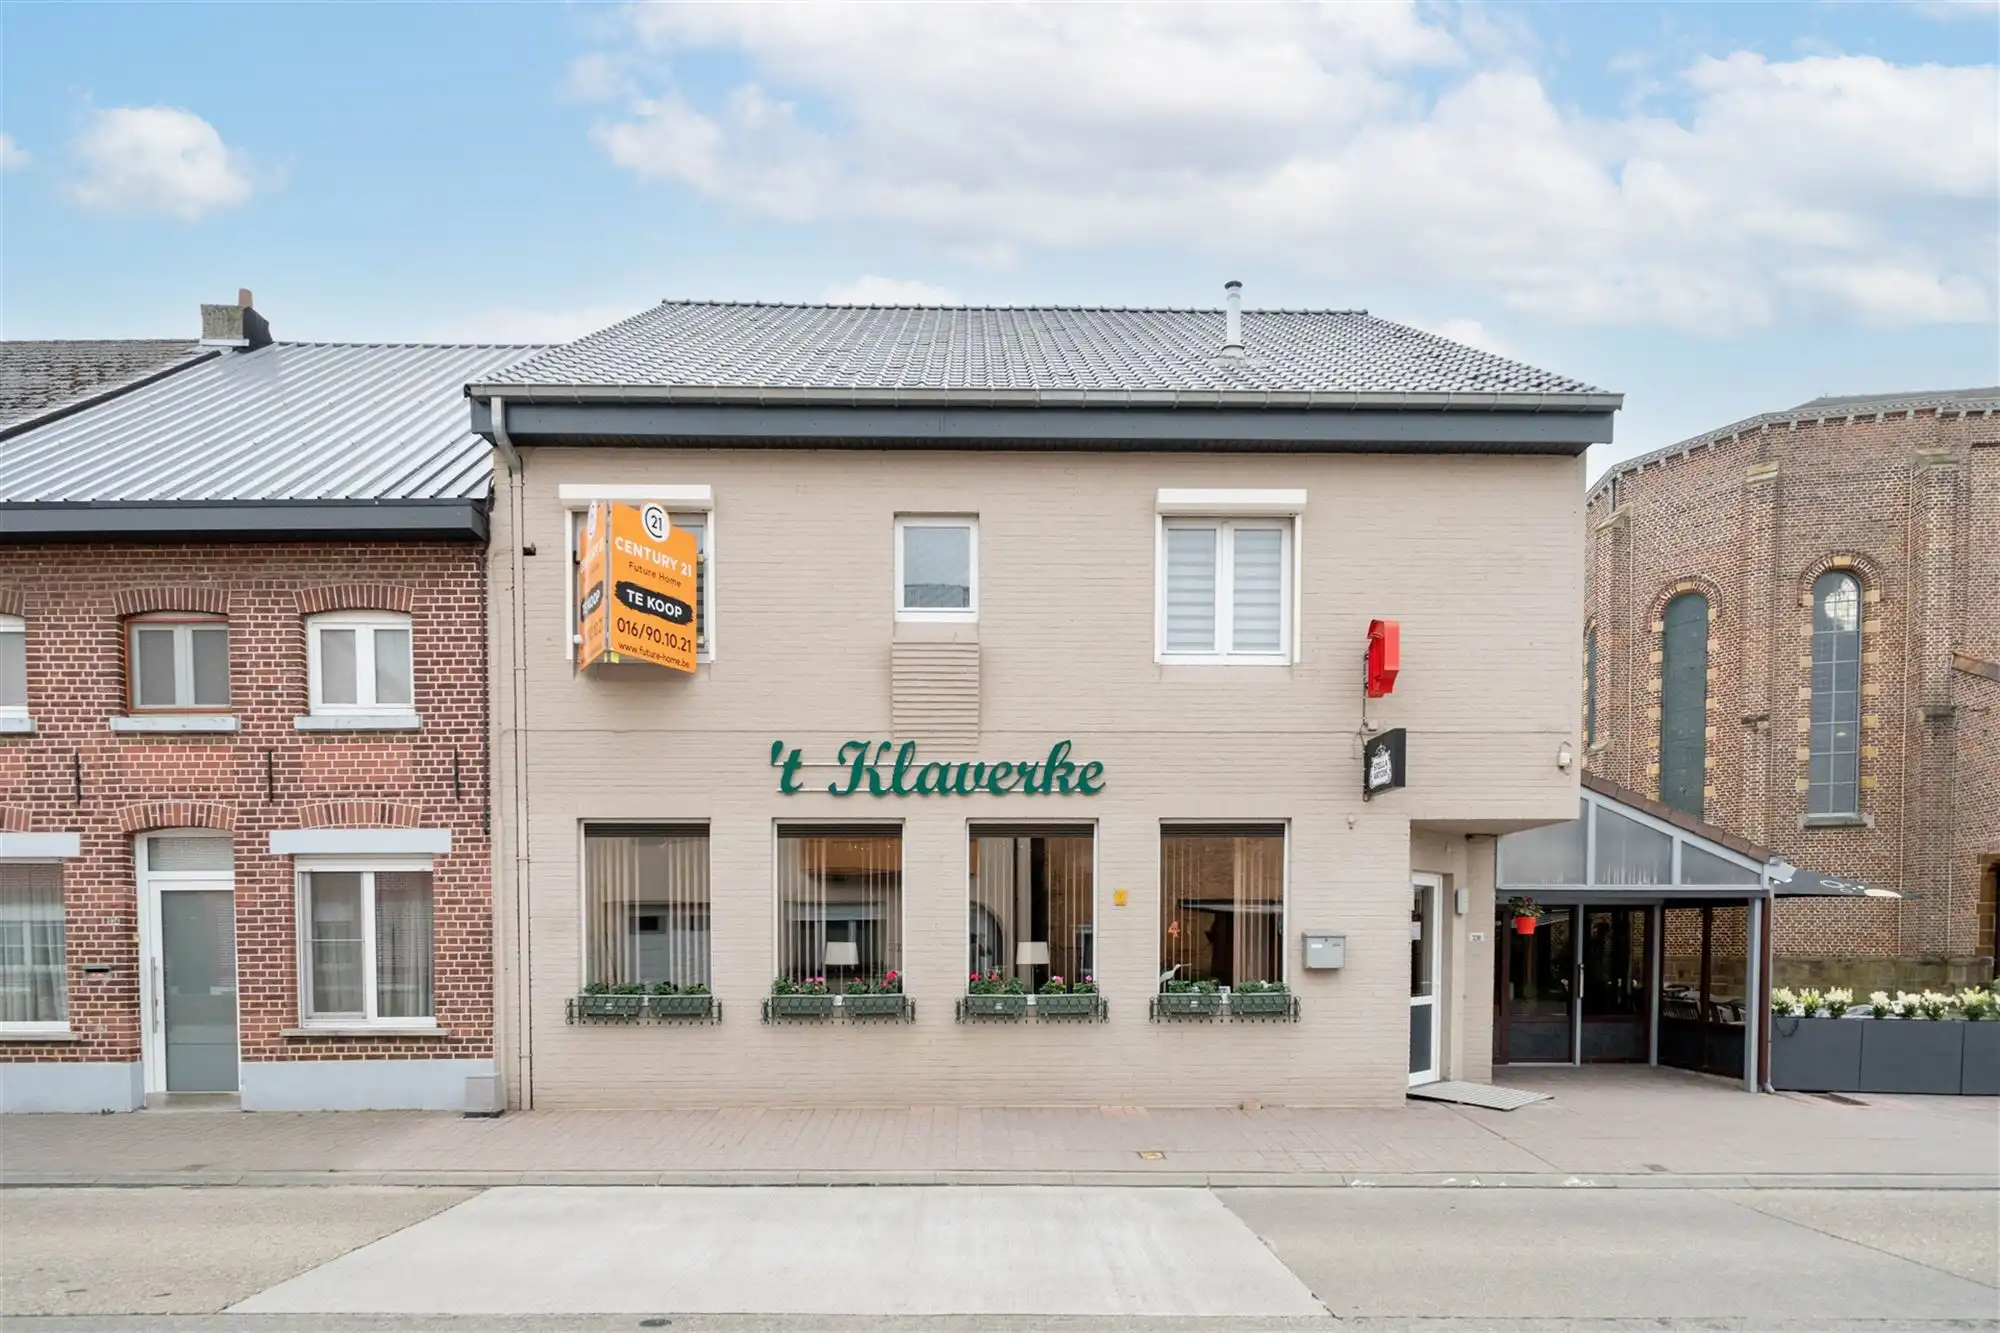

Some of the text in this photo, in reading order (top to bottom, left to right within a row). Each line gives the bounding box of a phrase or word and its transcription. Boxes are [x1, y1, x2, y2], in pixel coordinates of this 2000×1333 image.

[651, 515, 662, 531] 21
[615, 536, 678, 571] CENTURY
[681, 562, 692, 577] 21
[628, 560, 682, 588] Future Home
[626, 589, 682, 617] TE KOOP
[617, 617, 691, 653] 016/90.10.21
[618, 642, 690, 668] www.future-home.be
[771, 739, 1107, 797] 't Klaverke
